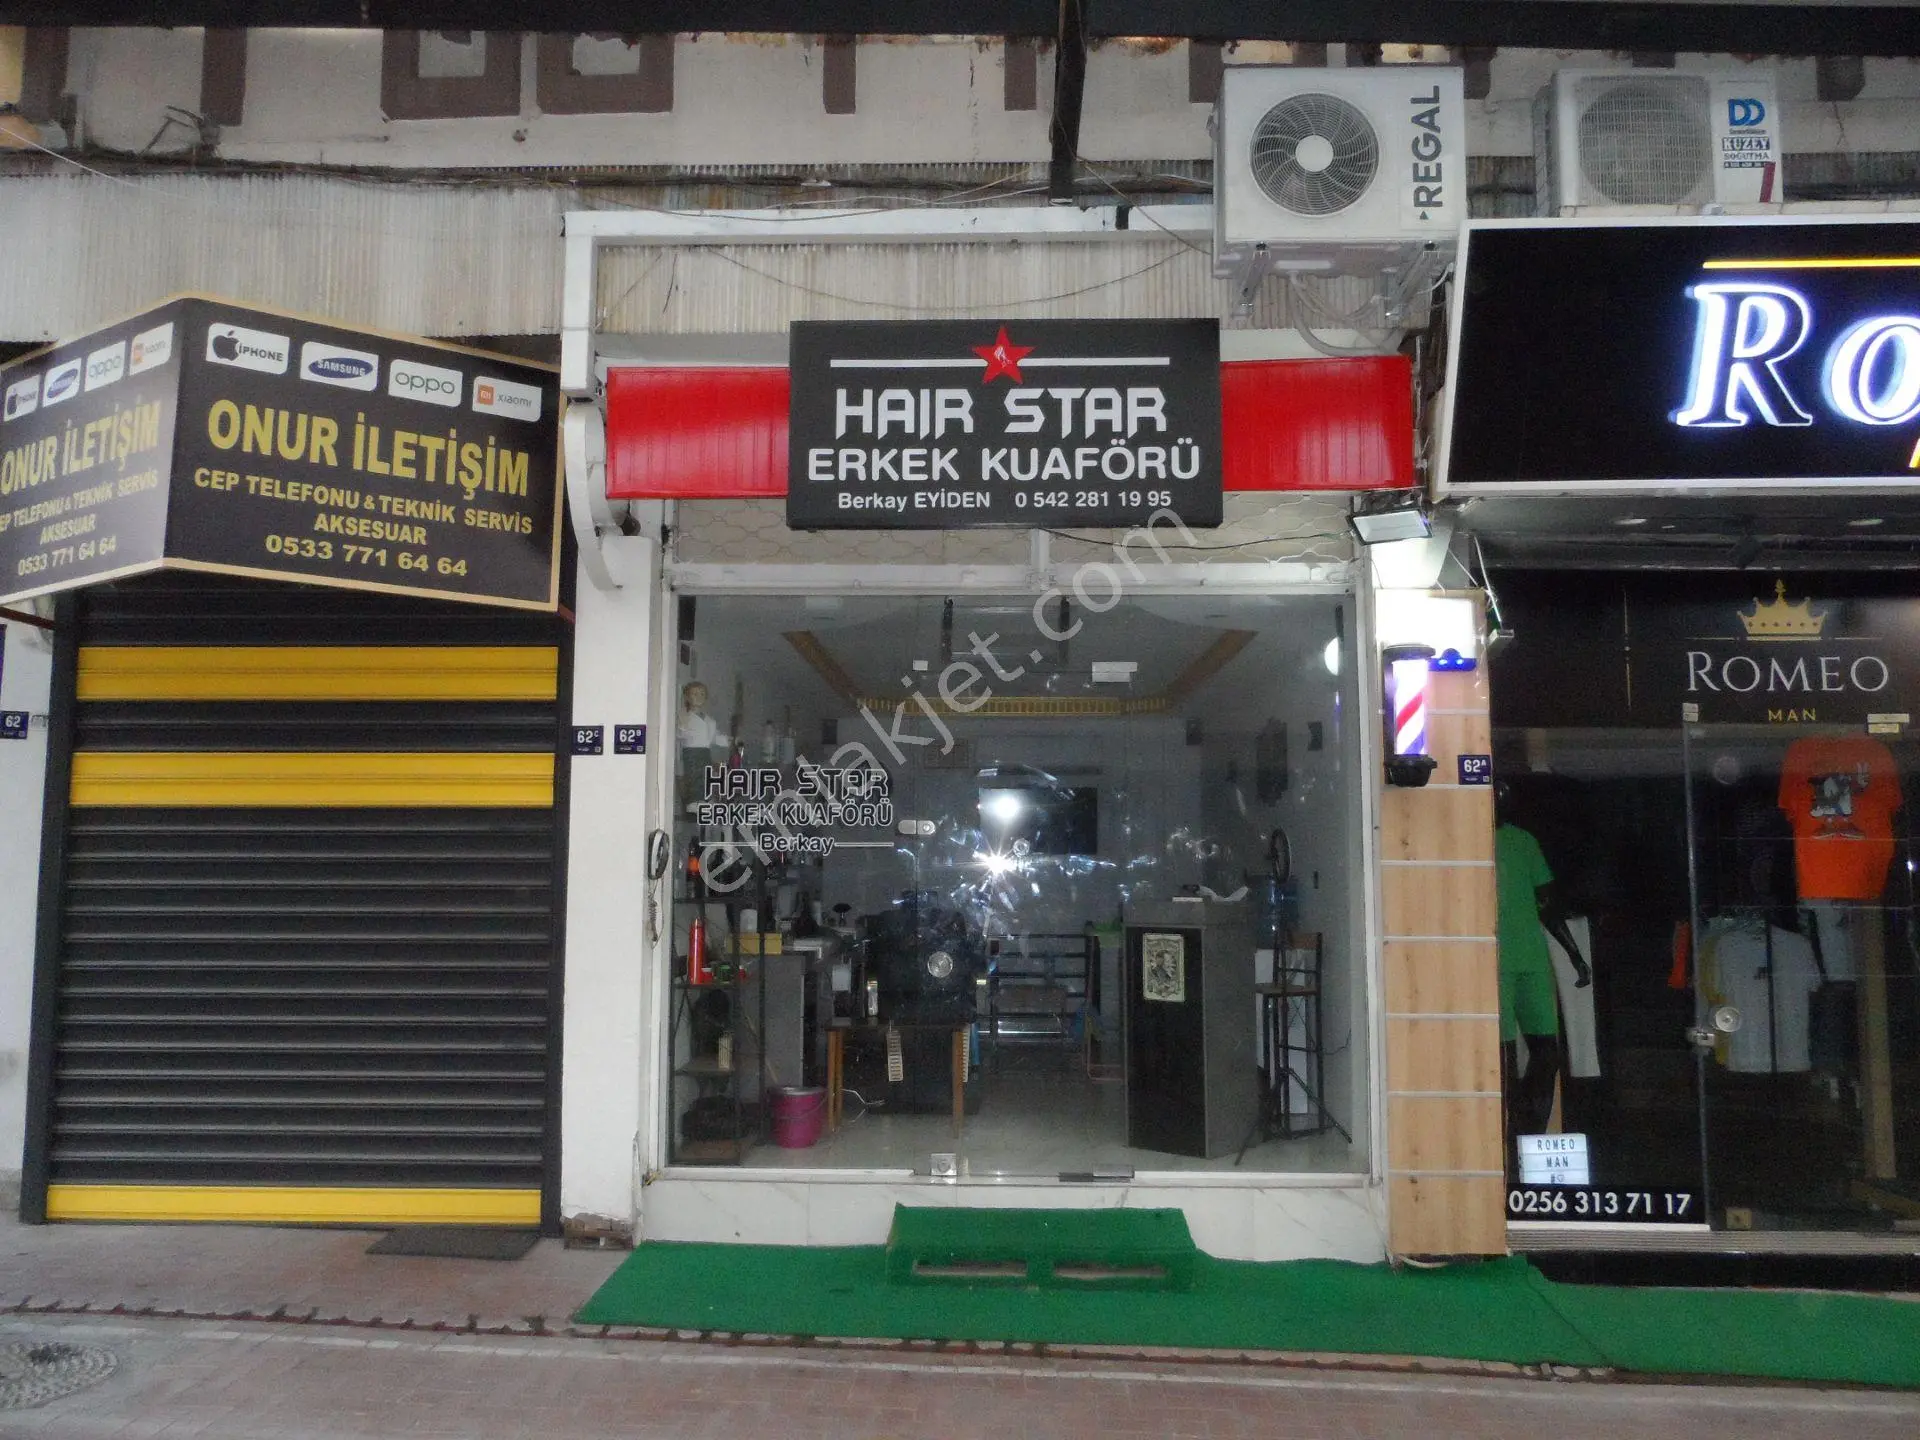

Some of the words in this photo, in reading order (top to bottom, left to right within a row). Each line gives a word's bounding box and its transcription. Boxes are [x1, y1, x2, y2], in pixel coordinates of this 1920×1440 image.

[1410, 85, 1443, 207] REGAL
[1723, 138, 1769, 150] KUZEY
[317, 360, 366, 376] SAMSUNG
[395, 372, 455, 394] oppo
[835, 388, 974, 440] HAIR
[1003, 387, 1168, 439] STAR
[0, 435, 58, 495] ONUR
[62, 394, 162, 475] İLETİŞİM
[208, 399, 338, 467] ONUR
[353, 412, 529, 500] İLETİŞİM
[808, 447, 960, 481] ERKEK
[981, 437, 1200, 481] KUAFÖRÜ
[13, 498, 65, 528] TELEFONU
[194, 467, 240, 491] CEP
[246, 475, 360, 509] TELEFONU
[363, 495, 376, 510] &
[378, 495, 456, 524] TEKNİK
[464, 508, 533, 534] SERVİS
[838, 491, 906, 513] Berkay
[914, 487, 991, 508] EYİDEN
[1015, 491, 1028, 508] 0
[1033, 492, 1069, 508] 542
[1075, 491, 1109, 507] 281
[1118, 491, 1141, 507] 19
[1147, 490, 1172, 506] 95
[40, 513, 96, 546] AKSESUAR
[314, 513, 427, 545] AKSESUAR
[18, 553, 48, 577] 0533
[52, 546, 74, 568] 771
[78, 540, 95, 561] 64
[265, 534, 333, 560] 0533
[342, 544, 387, 567] 771
[398, 552, 429, 572] 64
[437, 557, 468, 577] 64
[1687, 651, 1889, 692] ROMEO
[5, 715, 21, 728] 62
[1767, 707, 1817, 722] MAN
[704, 765, 782, 800] HAIR
[796, 765, 889, 800] STAR
[697, 803, 775, 826] ERKEK
[780, 798, 894, 827] KUAFÖRÜ
[760, 832, 835, 856] Berkay
[1537, 1138, 1575, 1151] ROMEO
[1546, 1155, 1569, 1168] MAN
[1508, 1190, 1567, 1213] 0256
[1574, 1191, 1619, 1215] 313
[1626, 1193, 1652, 1215] 71
[1664, 1193, 1691, 1216] 17
